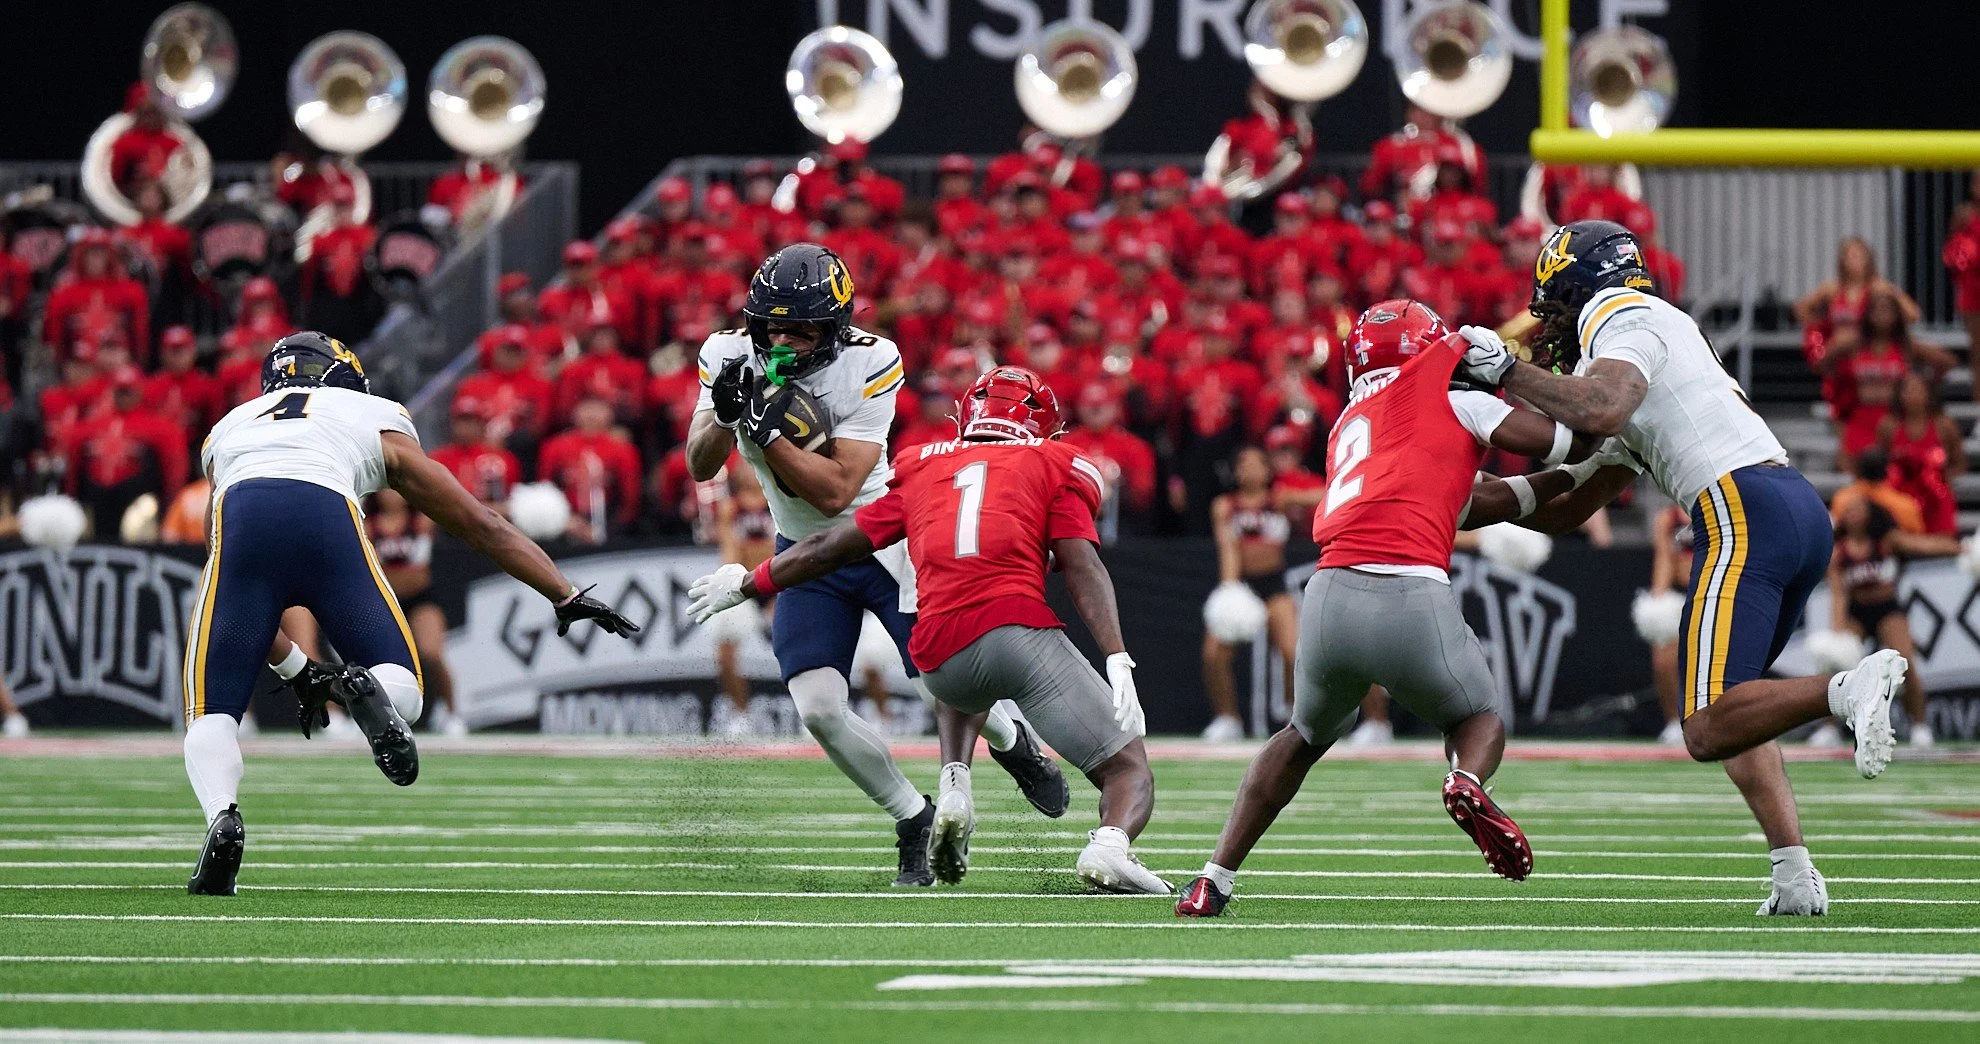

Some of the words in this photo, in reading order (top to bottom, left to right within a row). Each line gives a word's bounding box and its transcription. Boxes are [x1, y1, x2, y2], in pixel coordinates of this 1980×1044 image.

[770, 306, 790, 315] ACC
[253, 392, 312, 421] 4
[971, 422, 1029, 439] REBELS
[1323, 413, 1372, 520] 2
[952, 460, 988, 559] 1
